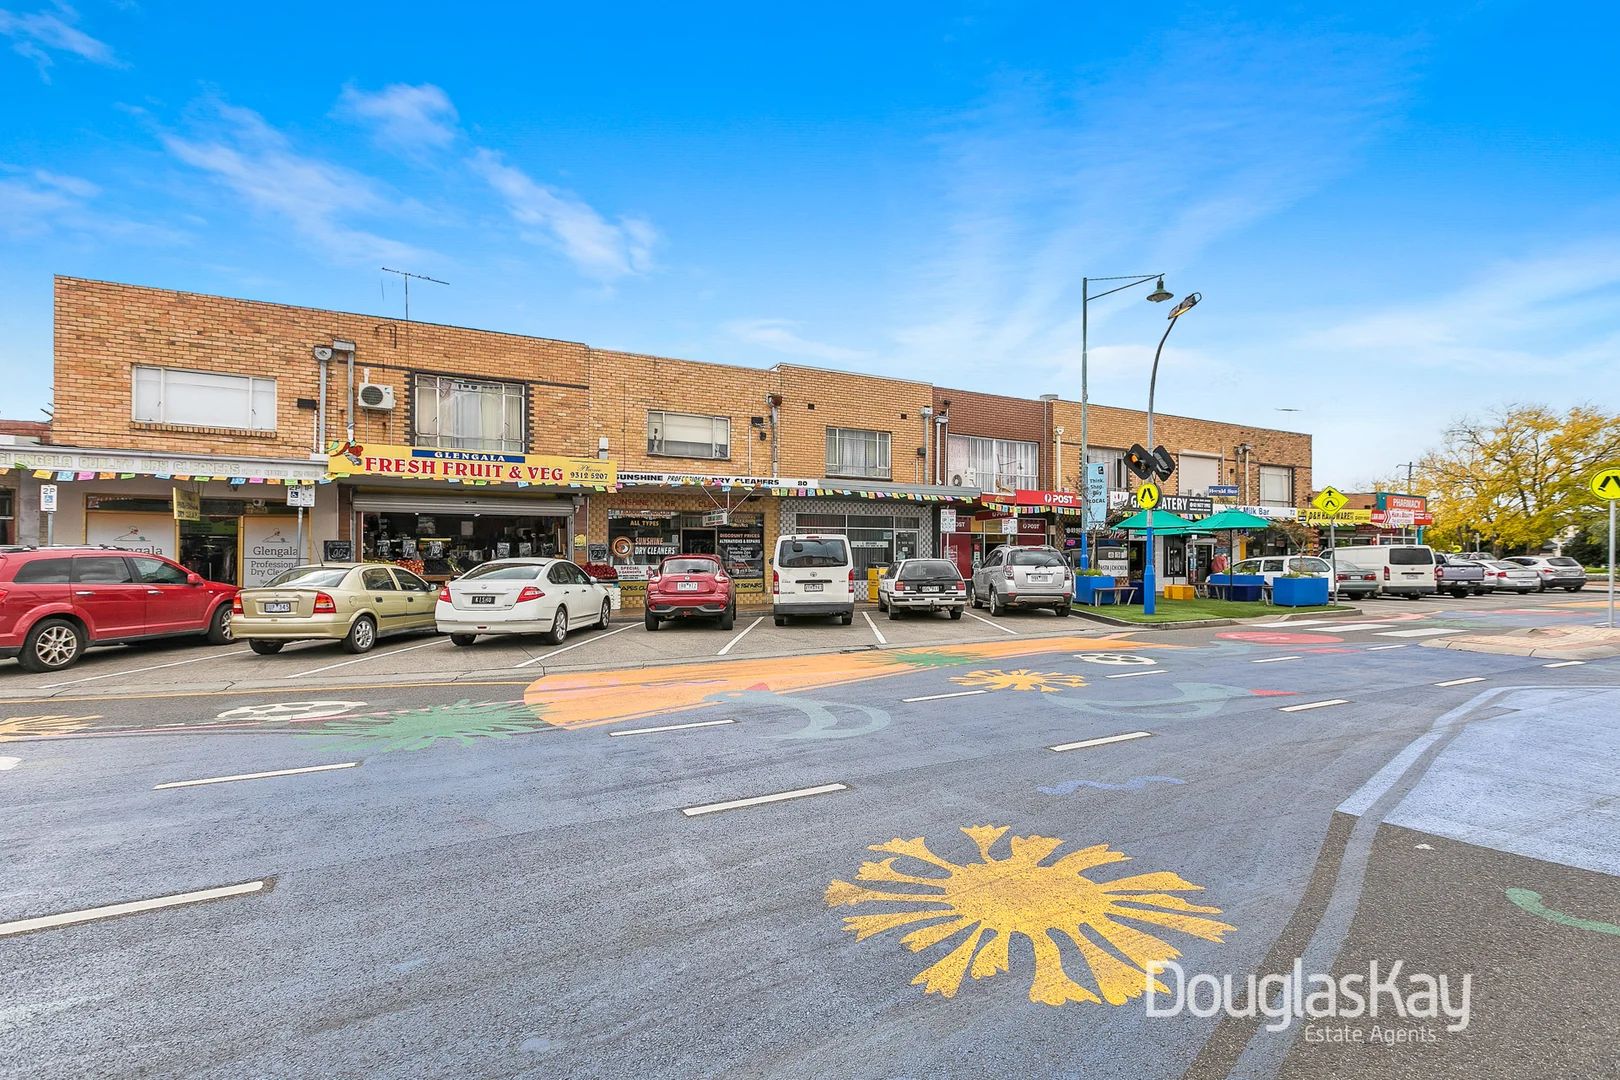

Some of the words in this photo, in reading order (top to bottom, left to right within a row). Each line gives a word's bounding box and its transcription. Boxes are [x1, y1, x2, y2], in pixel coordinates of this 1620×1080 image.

[434, 451, 505, 462] GLENGALA
[78, 457, 134, 469] QUALITY
[141, 460, 168, 471] DRY
[174, 462, 240, 474] CLEANERS
[365, 457, 436, 475] FRESH
[443, 461, 503, 478] FRUIT
[509, 466, 522, 479] &
[527, 466, 563, 481] VEG
[1053, 495, 1073, 503] POST
[1159, 496, 1188, 510] ATERY
[1393, 498, 1421, 508] PHARMACY
[635, 537, 663, 545] SUNSHINE
[253, 546, 298, 557] Glengala
[634, 547, 646, 555] DRY
[647, 547, 675, 555] CLEANERS
[251, 561, 297, 569] Professiona
[251, 569, 265, 577] Dry
